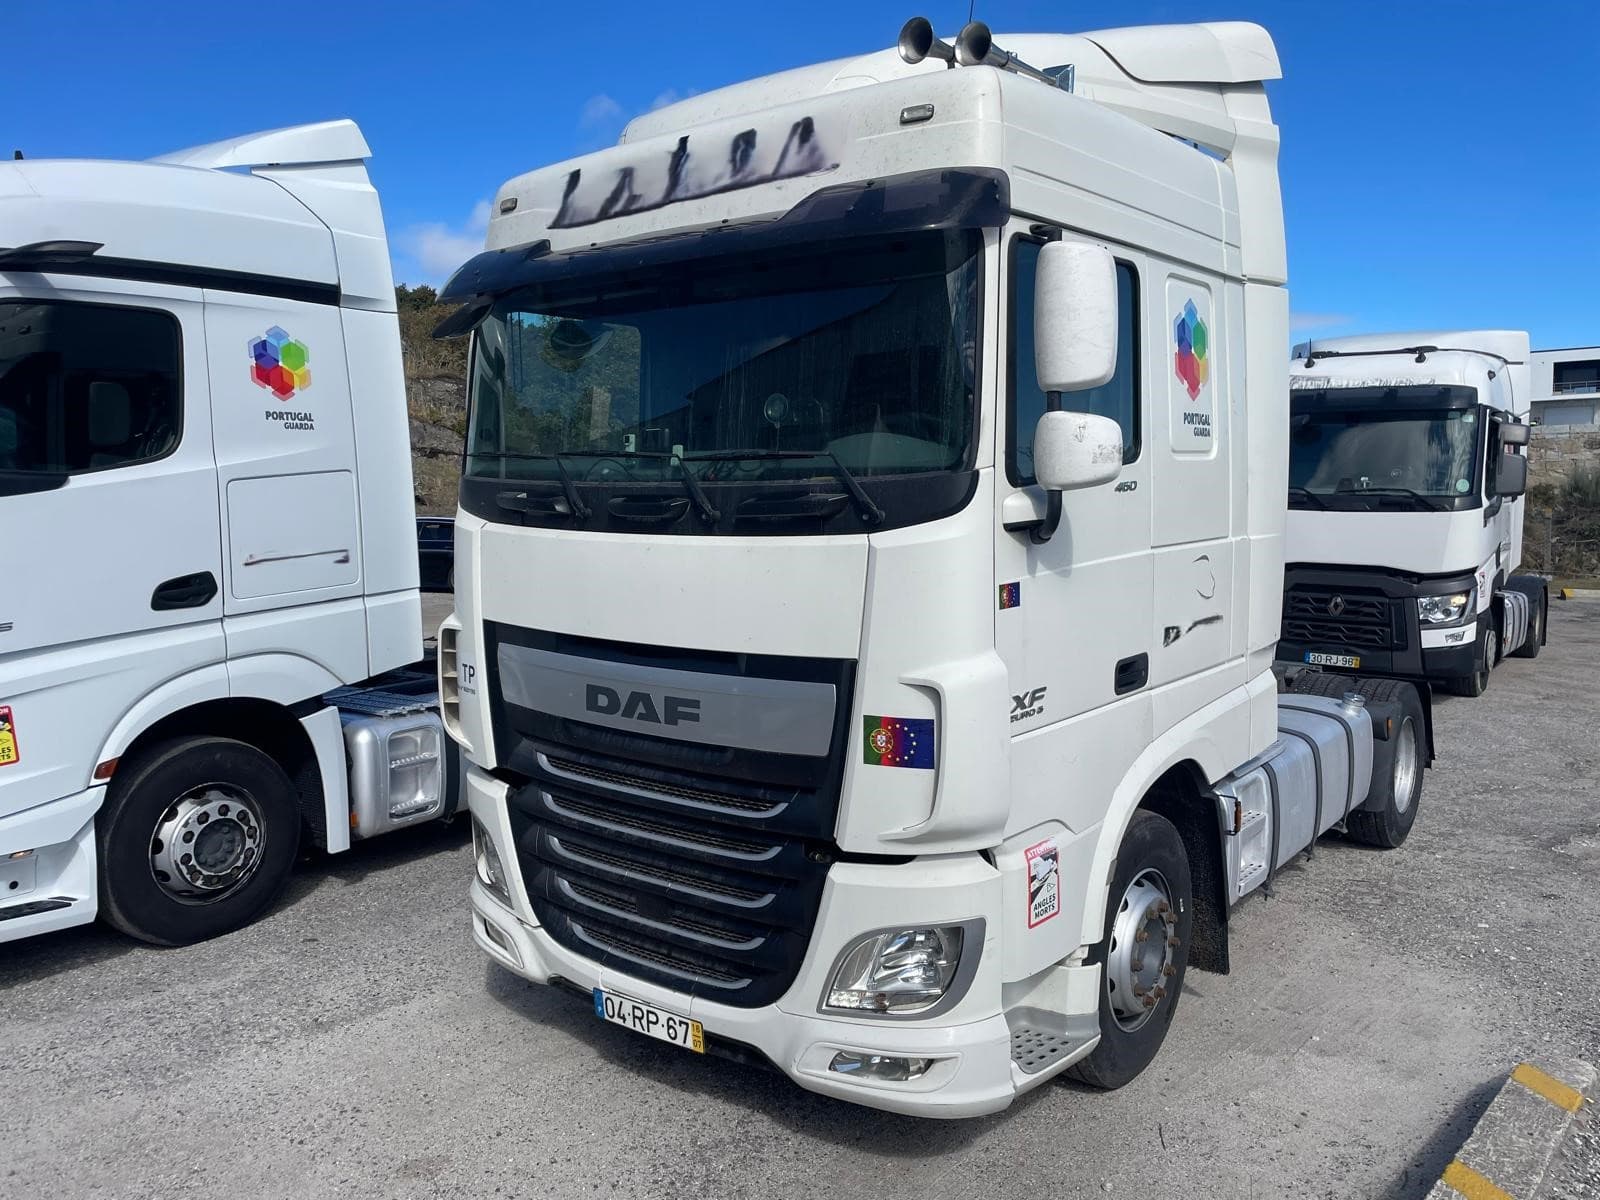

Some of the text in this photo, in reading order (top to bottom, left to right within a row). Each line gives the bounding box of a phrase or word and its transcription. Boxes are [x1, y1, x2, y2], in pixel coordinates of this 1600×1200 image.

[265, 411, 314, 422] PORTUGAL
[1183, 412, 1211, 426] PORTUGAL
[284, 422, 315, 430] GUARDA
[1193, 427, 1211, 437] GUARDA
[462, 663, 475, 684] TP
[586, 683, 701, 726] DAF
[1010, 686, 1047, 714] XF
[1033, 893, 1056, 911] ANGLES
[1034, 902, 1056, 919] MORTS
